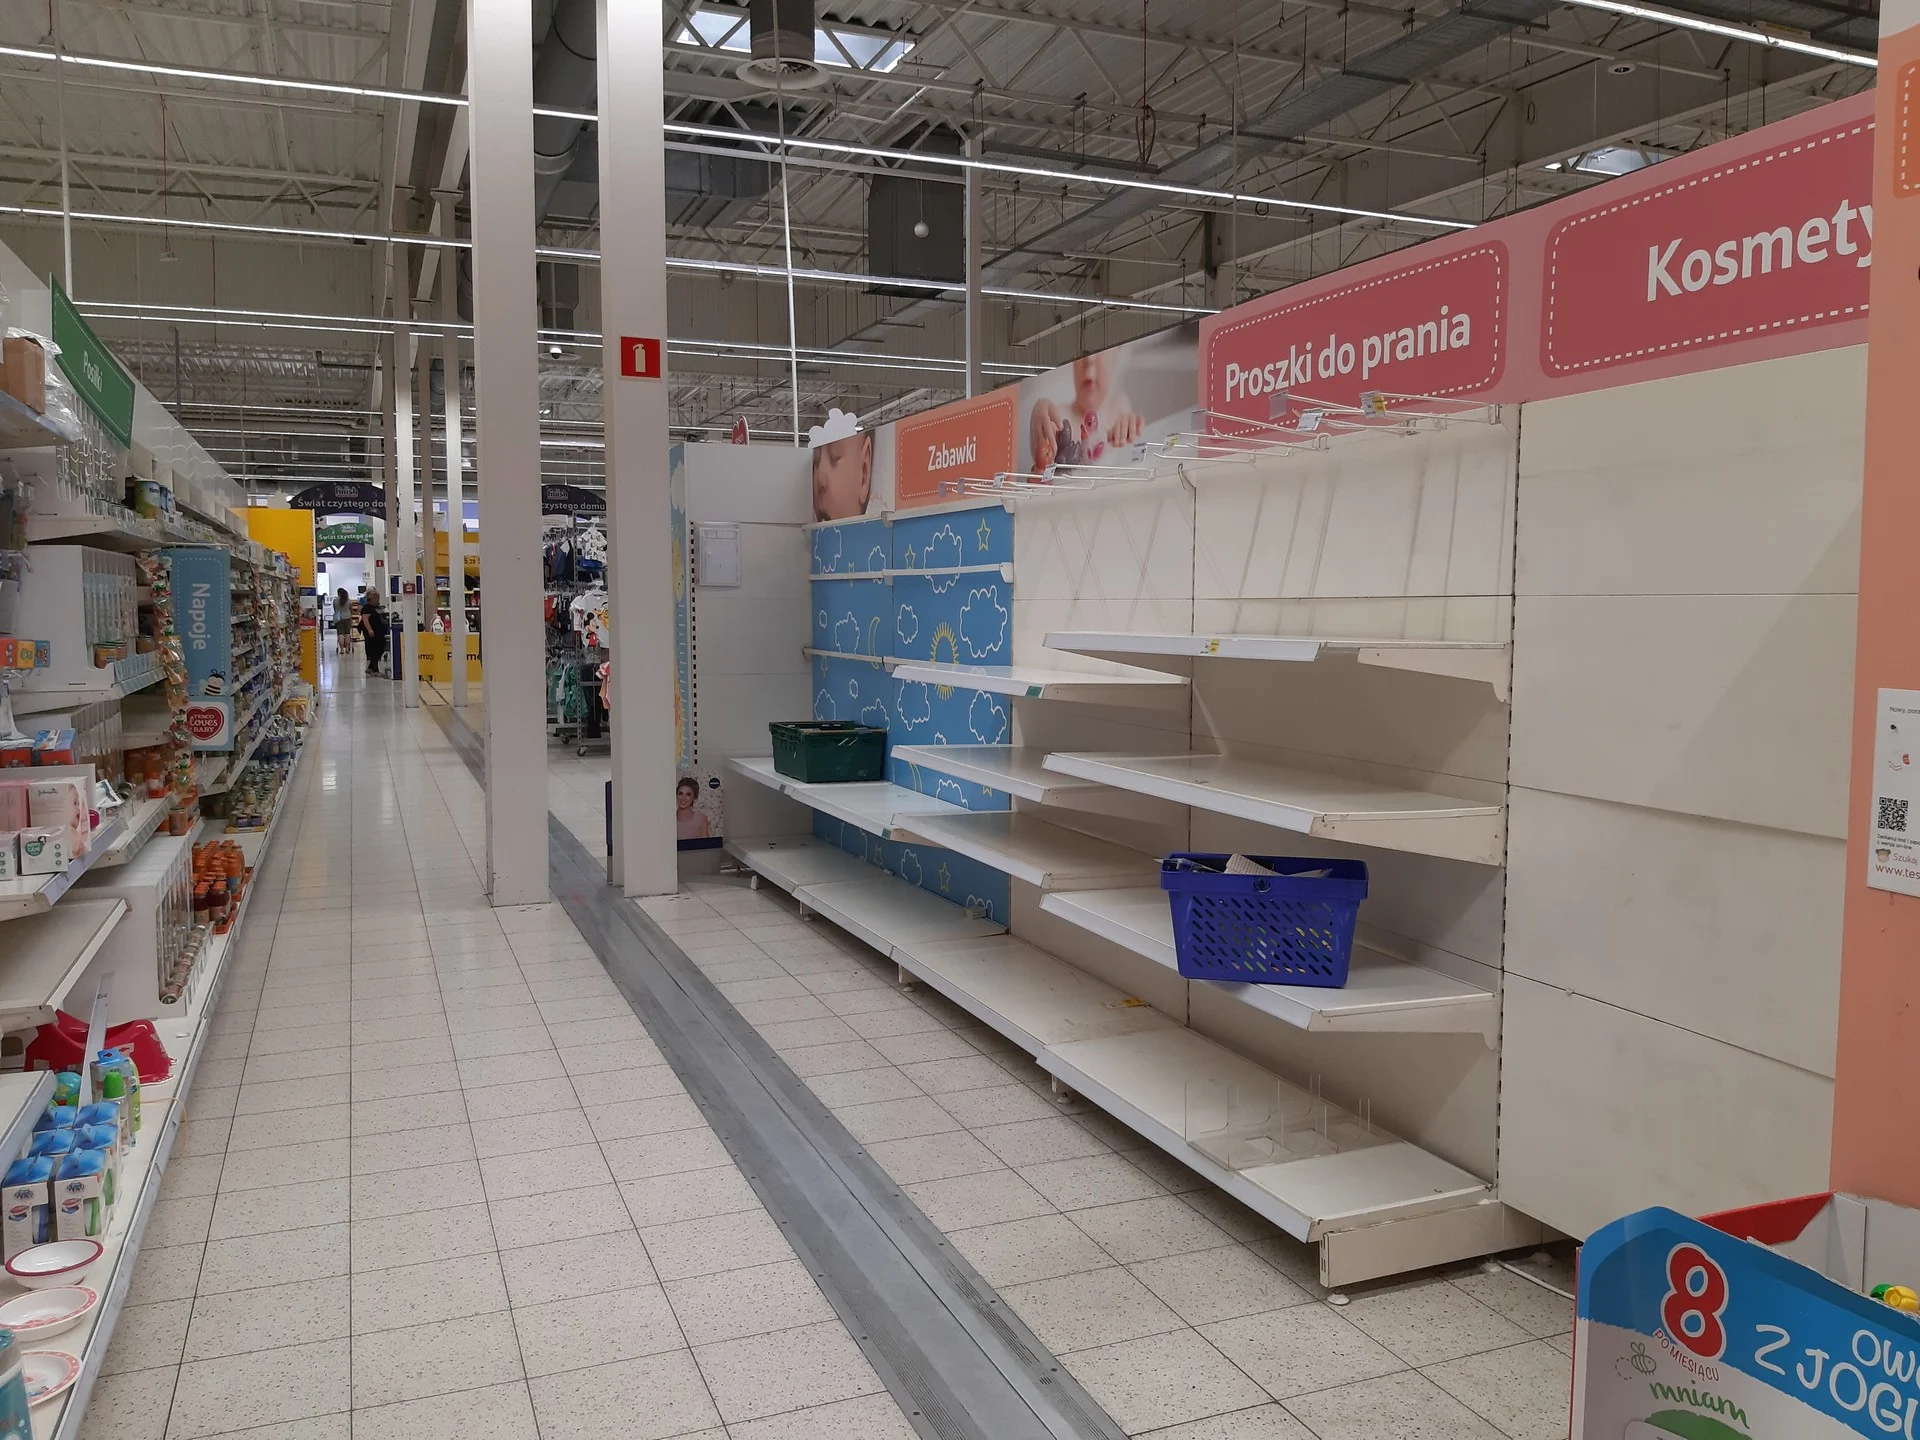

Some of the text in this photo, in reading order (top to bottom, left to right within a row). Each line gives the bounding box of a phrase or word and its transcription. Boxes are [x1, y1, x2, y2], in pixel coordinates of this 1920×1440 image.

[1225, 306, 1471, 402] Proszki do prania
[927, 435, 976, 471] Zabawki
[297, 497, 326, 507] Świat
[327, 501, 371, 509] czystego
[580, 502, 606, 510] domu
[317, 545, 345, 554] AY
[188, 583, 211, 650] Napoje
[189, 715, 218, 727] loves
[1893, 853, 1917, 866] Szukaj
[1661, 1242, 1729, 1360] 8
[1654, 1329, 1720, 1381] PO MIESIĄCU
[1852, 1329, 1920, 1390] OW
[1648, 1379, 1751, 1430] mniam
